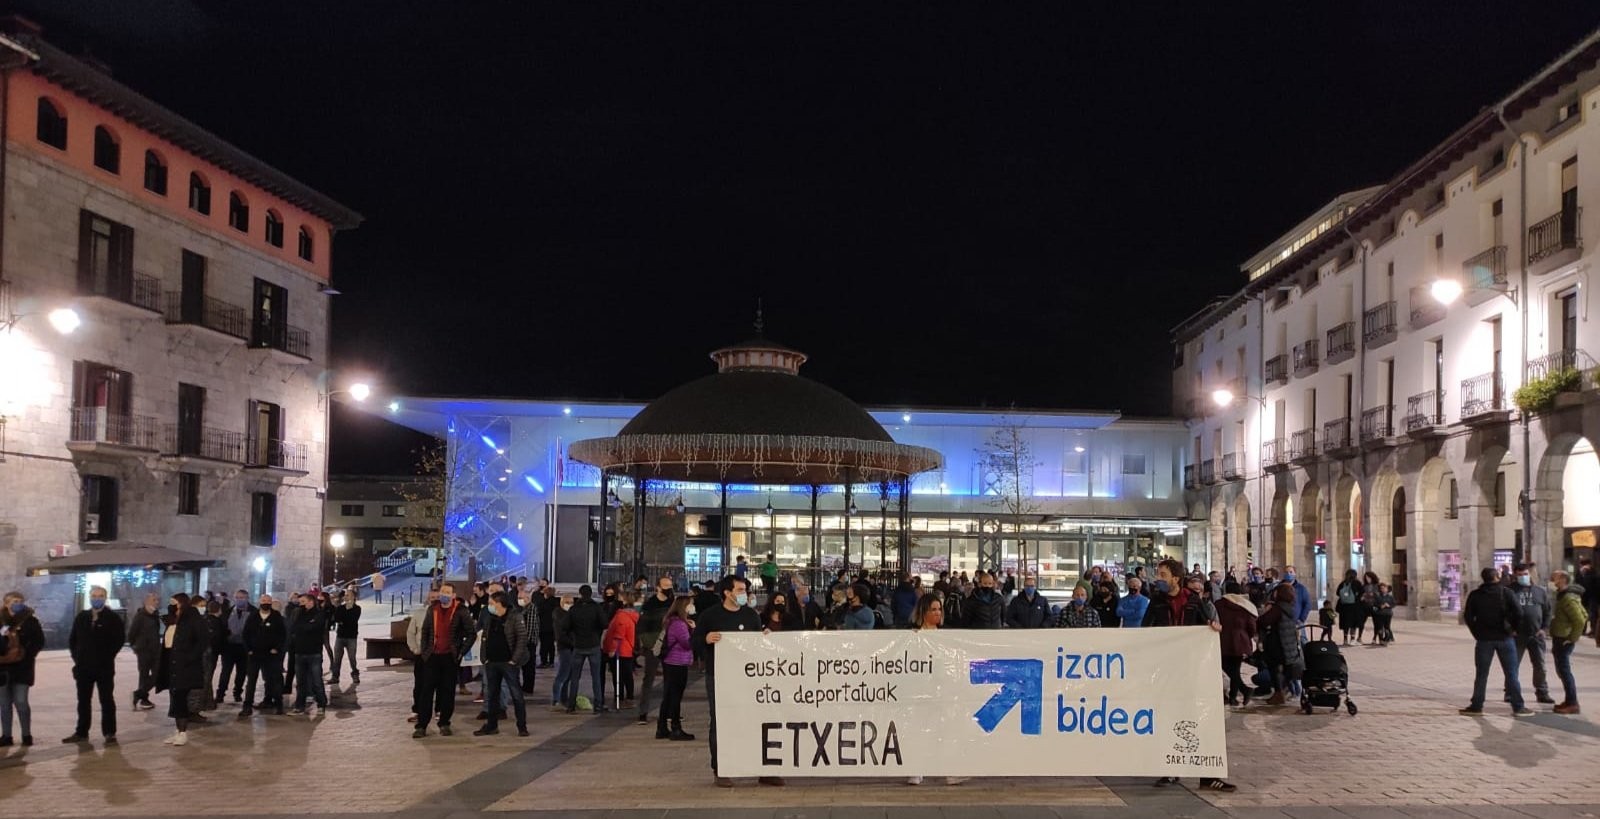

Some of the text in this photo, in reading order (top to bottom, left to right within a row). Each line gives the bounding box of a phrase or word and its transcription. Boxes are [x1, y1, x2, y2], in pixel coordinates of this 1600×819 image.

[744, 650, 933, 683] euskal preso, iheslari
[1057, 646, 1125, 680] izan
[755, 681, 898, 708] eta deportatuak
[1057, 693, 1154, 736] bidea
[761, 720, 903, 768] ETXERA
